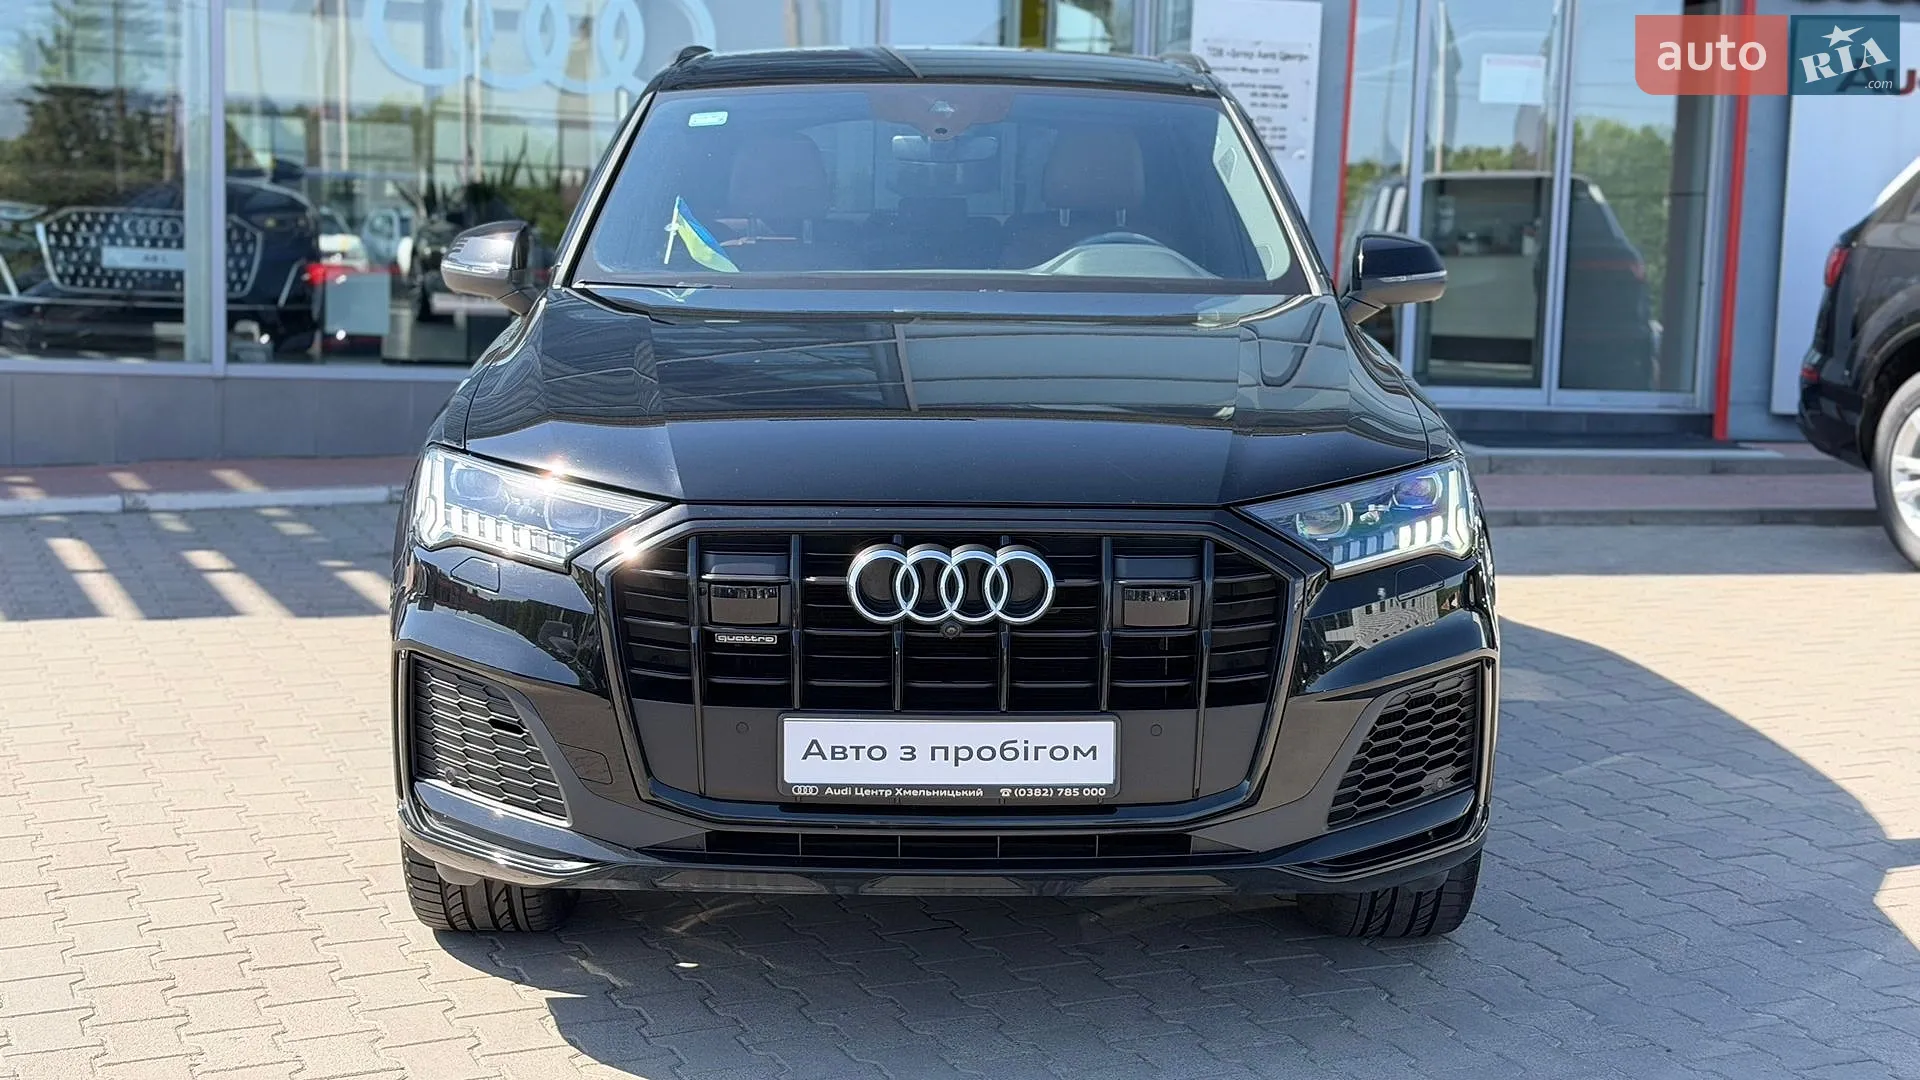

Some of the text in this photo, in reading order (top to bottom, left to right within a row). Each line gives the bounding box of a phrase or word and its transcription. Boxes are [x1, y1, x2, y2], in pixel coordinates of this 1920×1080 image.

[717, 634, 775, 643] quattro
[800, 738, 1098, 767] Авто з пробігом
[824, 786, 1106, 798] Audi Центр Хмельницький (0382) 785 000
